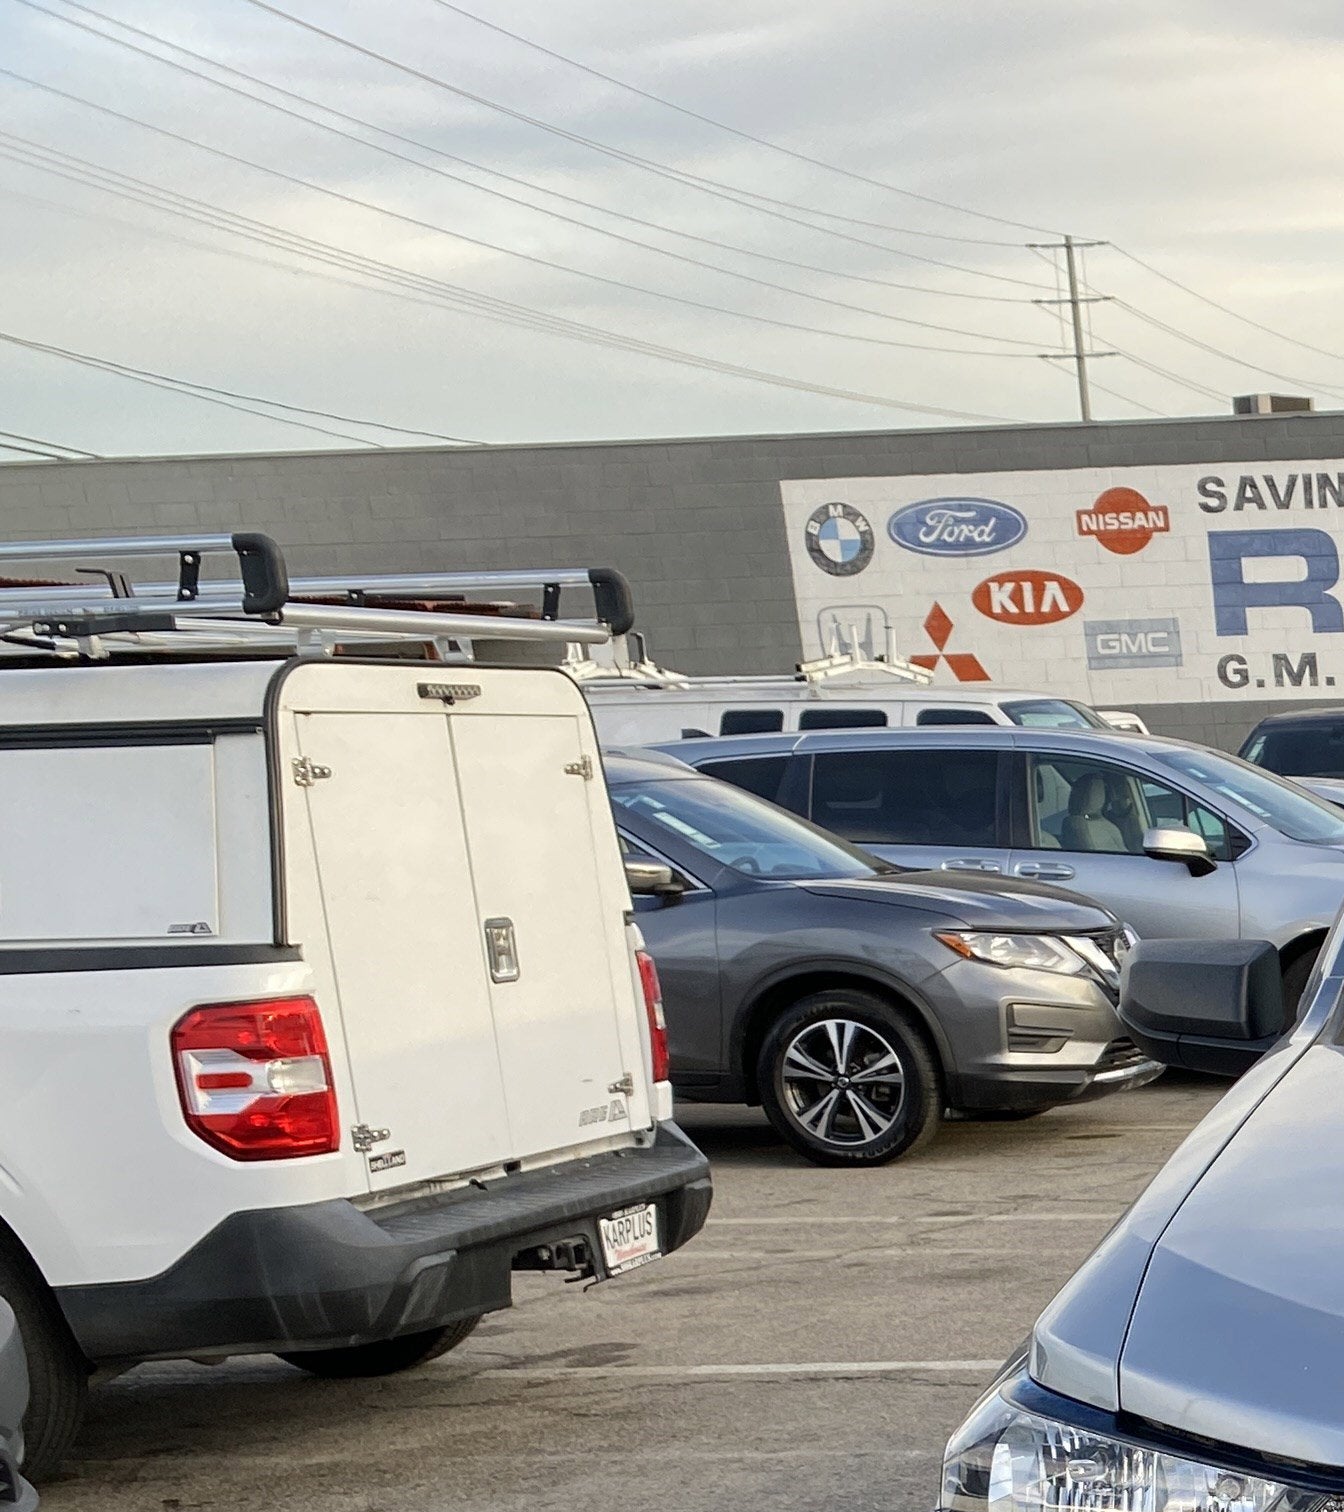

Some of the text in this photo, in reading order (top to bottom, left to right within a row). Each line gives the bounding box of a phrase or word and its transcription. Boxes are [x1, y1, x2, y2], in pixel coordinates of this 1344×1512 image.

[807, 503, 871, 535] BMW
[919, 509, 997, 543] Ford
[1081, 511, 1165, 531] NISSAN
[987, 581, 1070, 615] KIA
[1096, 631, 1170, 654] GMC
[1217, 652, 1335, 689] G.M.
[603, 1211, 653, 1251] KARPLUS
